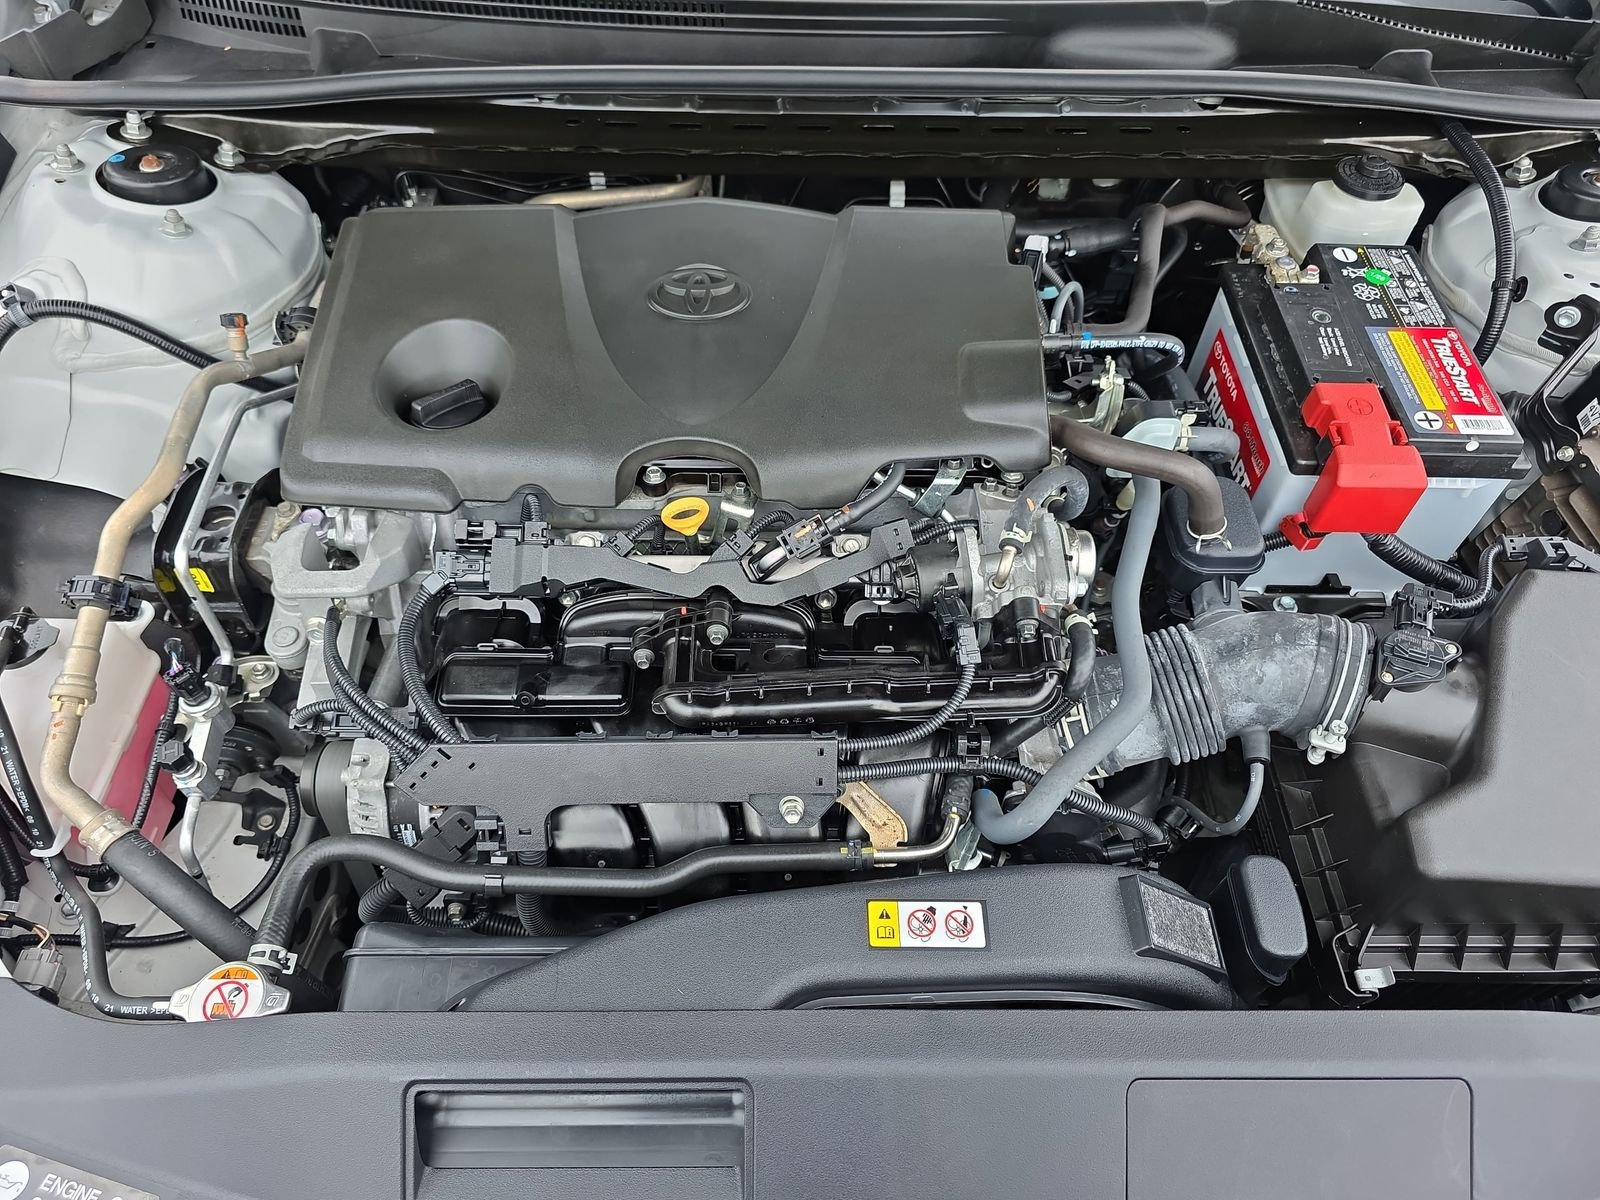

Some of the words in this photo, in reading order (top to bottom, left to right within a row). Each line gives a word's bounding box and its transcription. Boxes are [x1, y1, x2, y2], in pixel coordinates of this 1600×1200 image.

[1430, 337, 1480, 405] TRUESTART
[1453, 341, 1472, 367] TOYOTA
[1219, 355, 1238, 402] TOYOTA
[0, 745, 9, 755] 21
[5, 759, 20, 787] WATER
[15, 787, 30, 812] >EPDM<
[31, 828, 40, 836] 10
[36, 840, 44, 848] 21
[91, 993, 100, 1004] 10
[104, 1003, 114, 1013] 21
[120, 1005, 148, 1015] WATER
[39, 1172, 102, 1200] ENGINE
